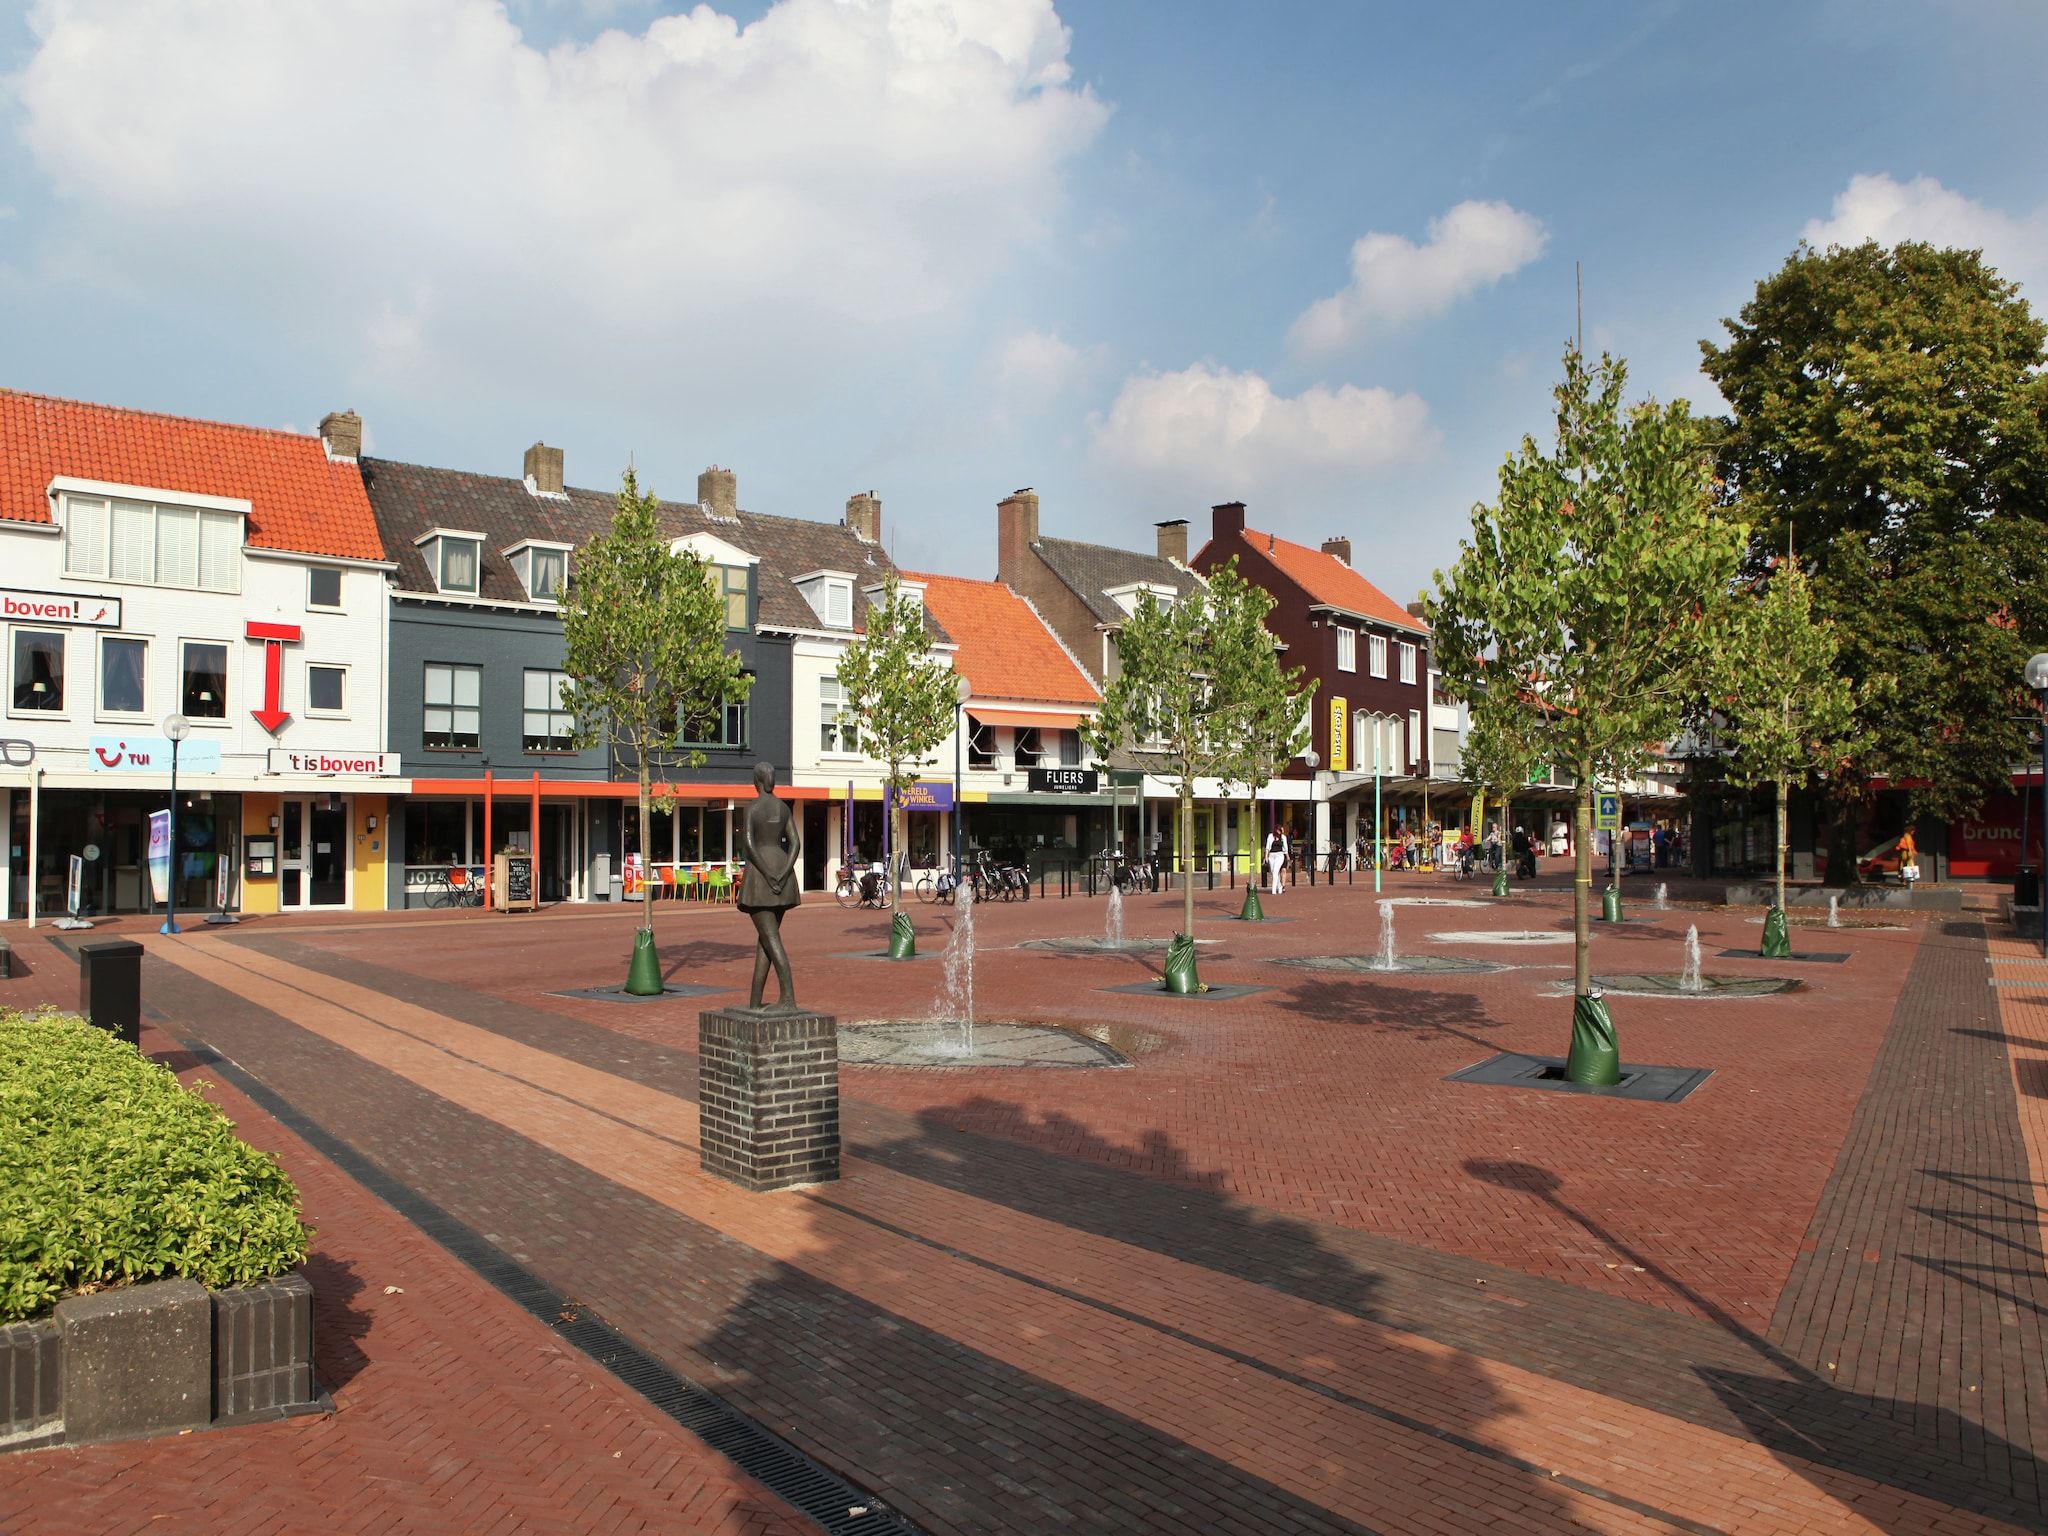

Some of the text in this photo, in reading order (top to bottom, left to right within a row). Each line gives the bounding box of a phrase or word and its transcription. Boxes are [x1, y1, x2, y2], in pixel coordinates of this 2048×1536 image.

[4, 597, 79, 619] boven!
[1333, 705, 1343, 758] Intertoys
[128, 753, 151, 766] TUI
[289, 754, 384, 772] 't is boven!
[1046, 771, 1084, 784] FLIERS
[900, 786, 929, 796] WERELD
[910, 795, 936, 804] WINKEL
[407, 871, 447, 884] JOTA
